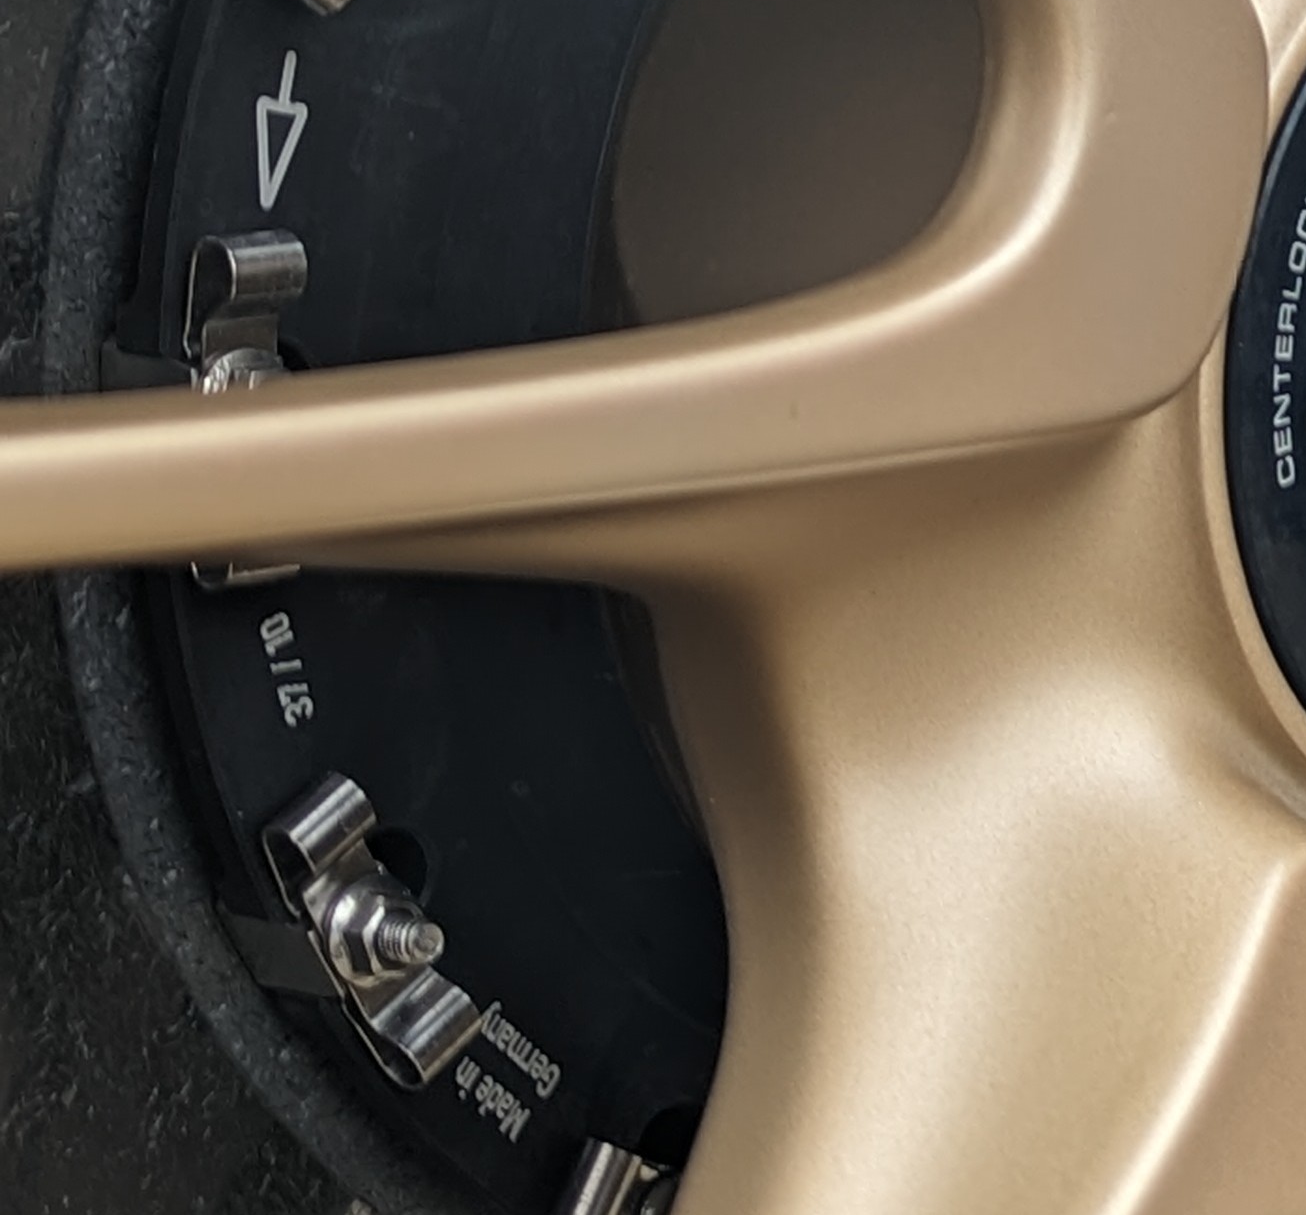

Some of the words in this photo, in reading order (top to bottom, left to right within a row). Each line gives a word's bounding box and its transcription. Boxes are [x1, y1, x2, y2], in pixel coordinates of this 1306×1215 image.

[455, 1055, 482, 1101] in
[481, 1000, 561, 1100] Germany
[474, 1074, 531, 1144] Made
